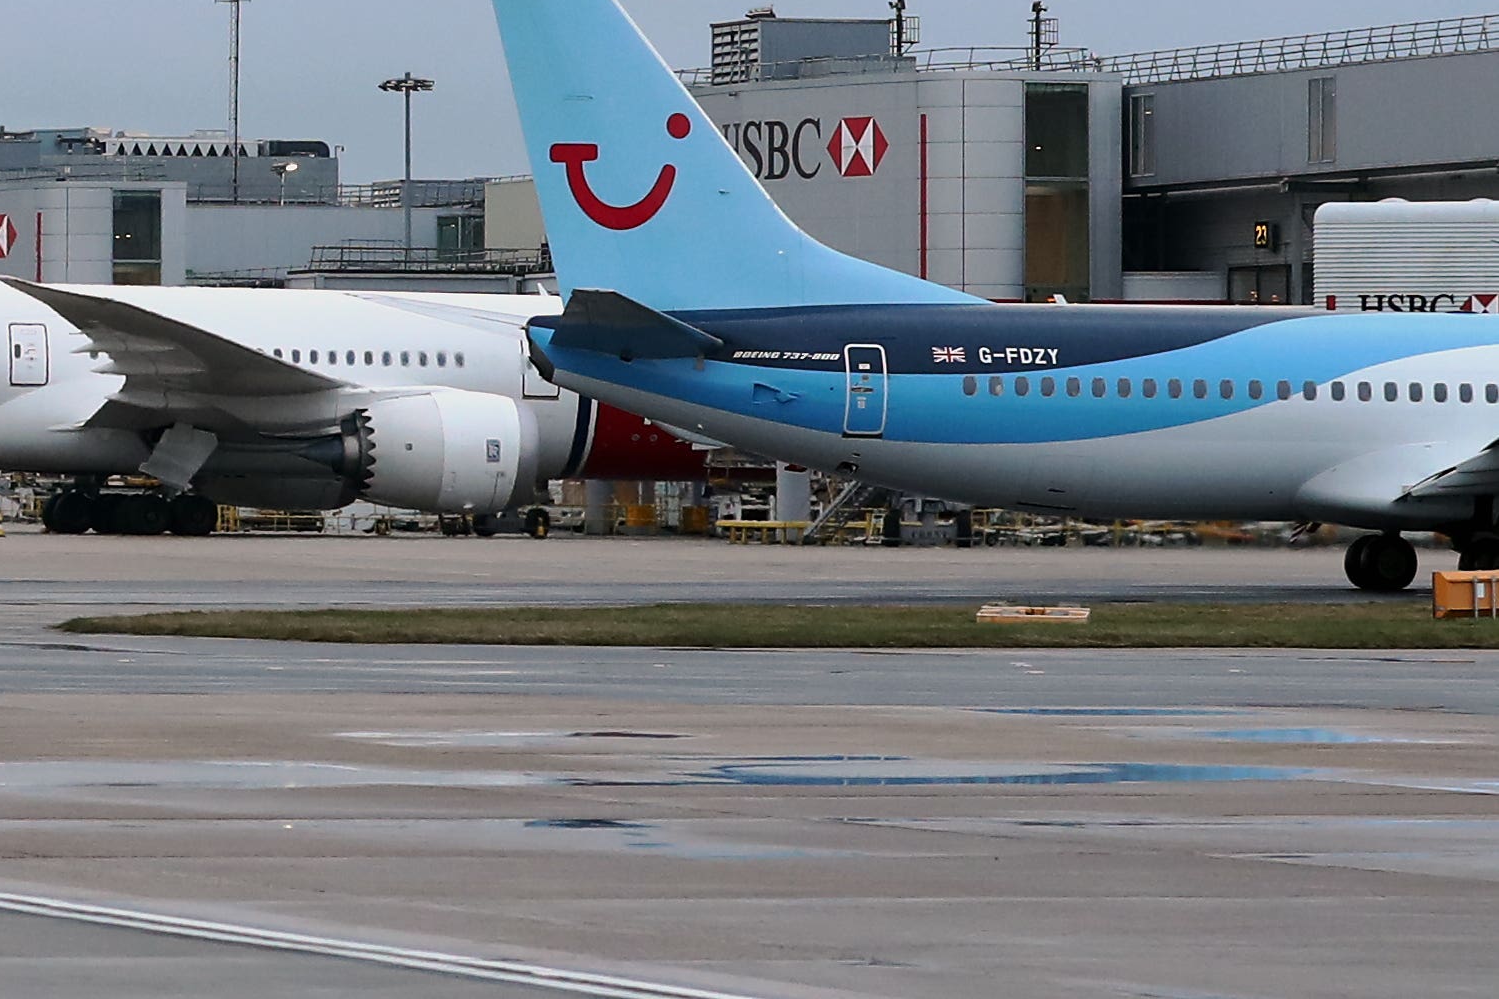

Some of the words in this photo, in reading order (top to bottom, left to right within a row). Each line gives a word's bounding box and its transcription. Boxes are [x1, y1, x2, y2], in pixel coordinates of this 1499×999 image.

[1255, 225, 1268, 245] 23
[732, 351, 780, 359] BOEING
[783, 352, 841, 360] 737-800
[978, 346, 1058, 364] G-FDZY
